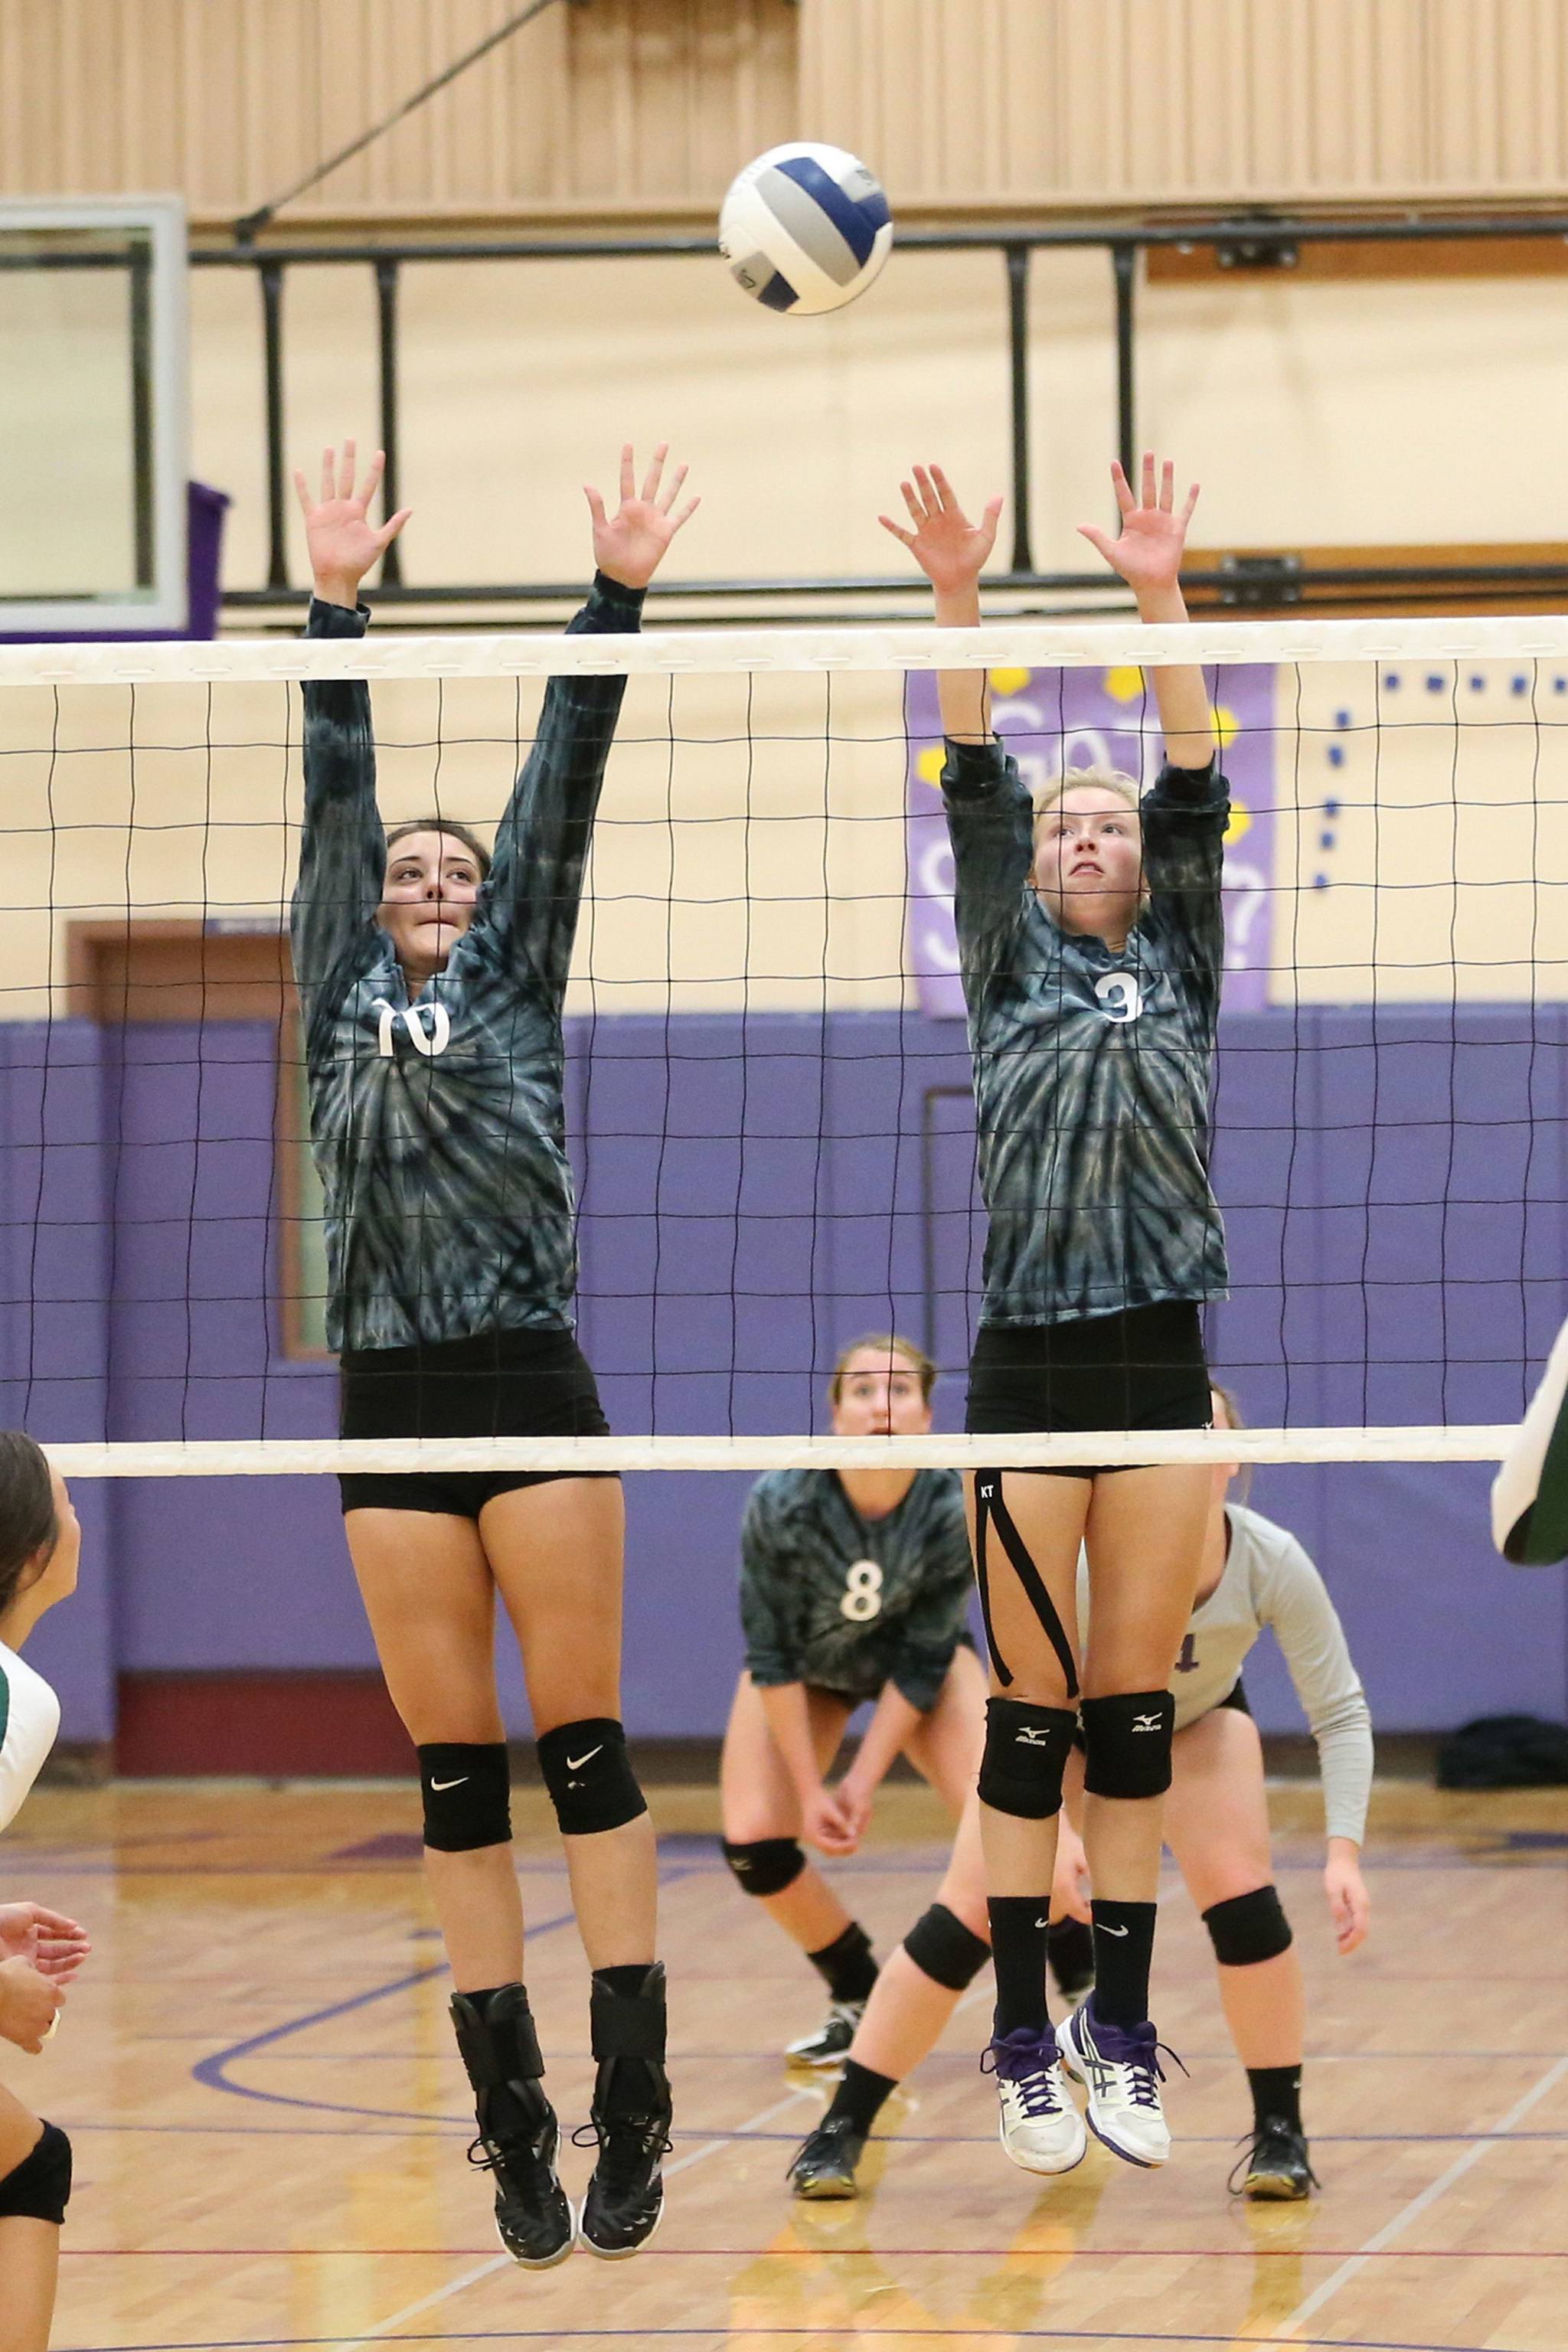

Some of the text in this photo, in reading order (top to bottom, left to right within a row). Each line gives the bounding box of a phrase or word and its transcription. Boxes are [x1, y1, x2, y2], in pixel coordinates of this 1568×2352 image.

[371, 998, 450, 1057] 10
[981, 1485, 994, 1498] KT
[840, 1560, 882, 1622] 8
